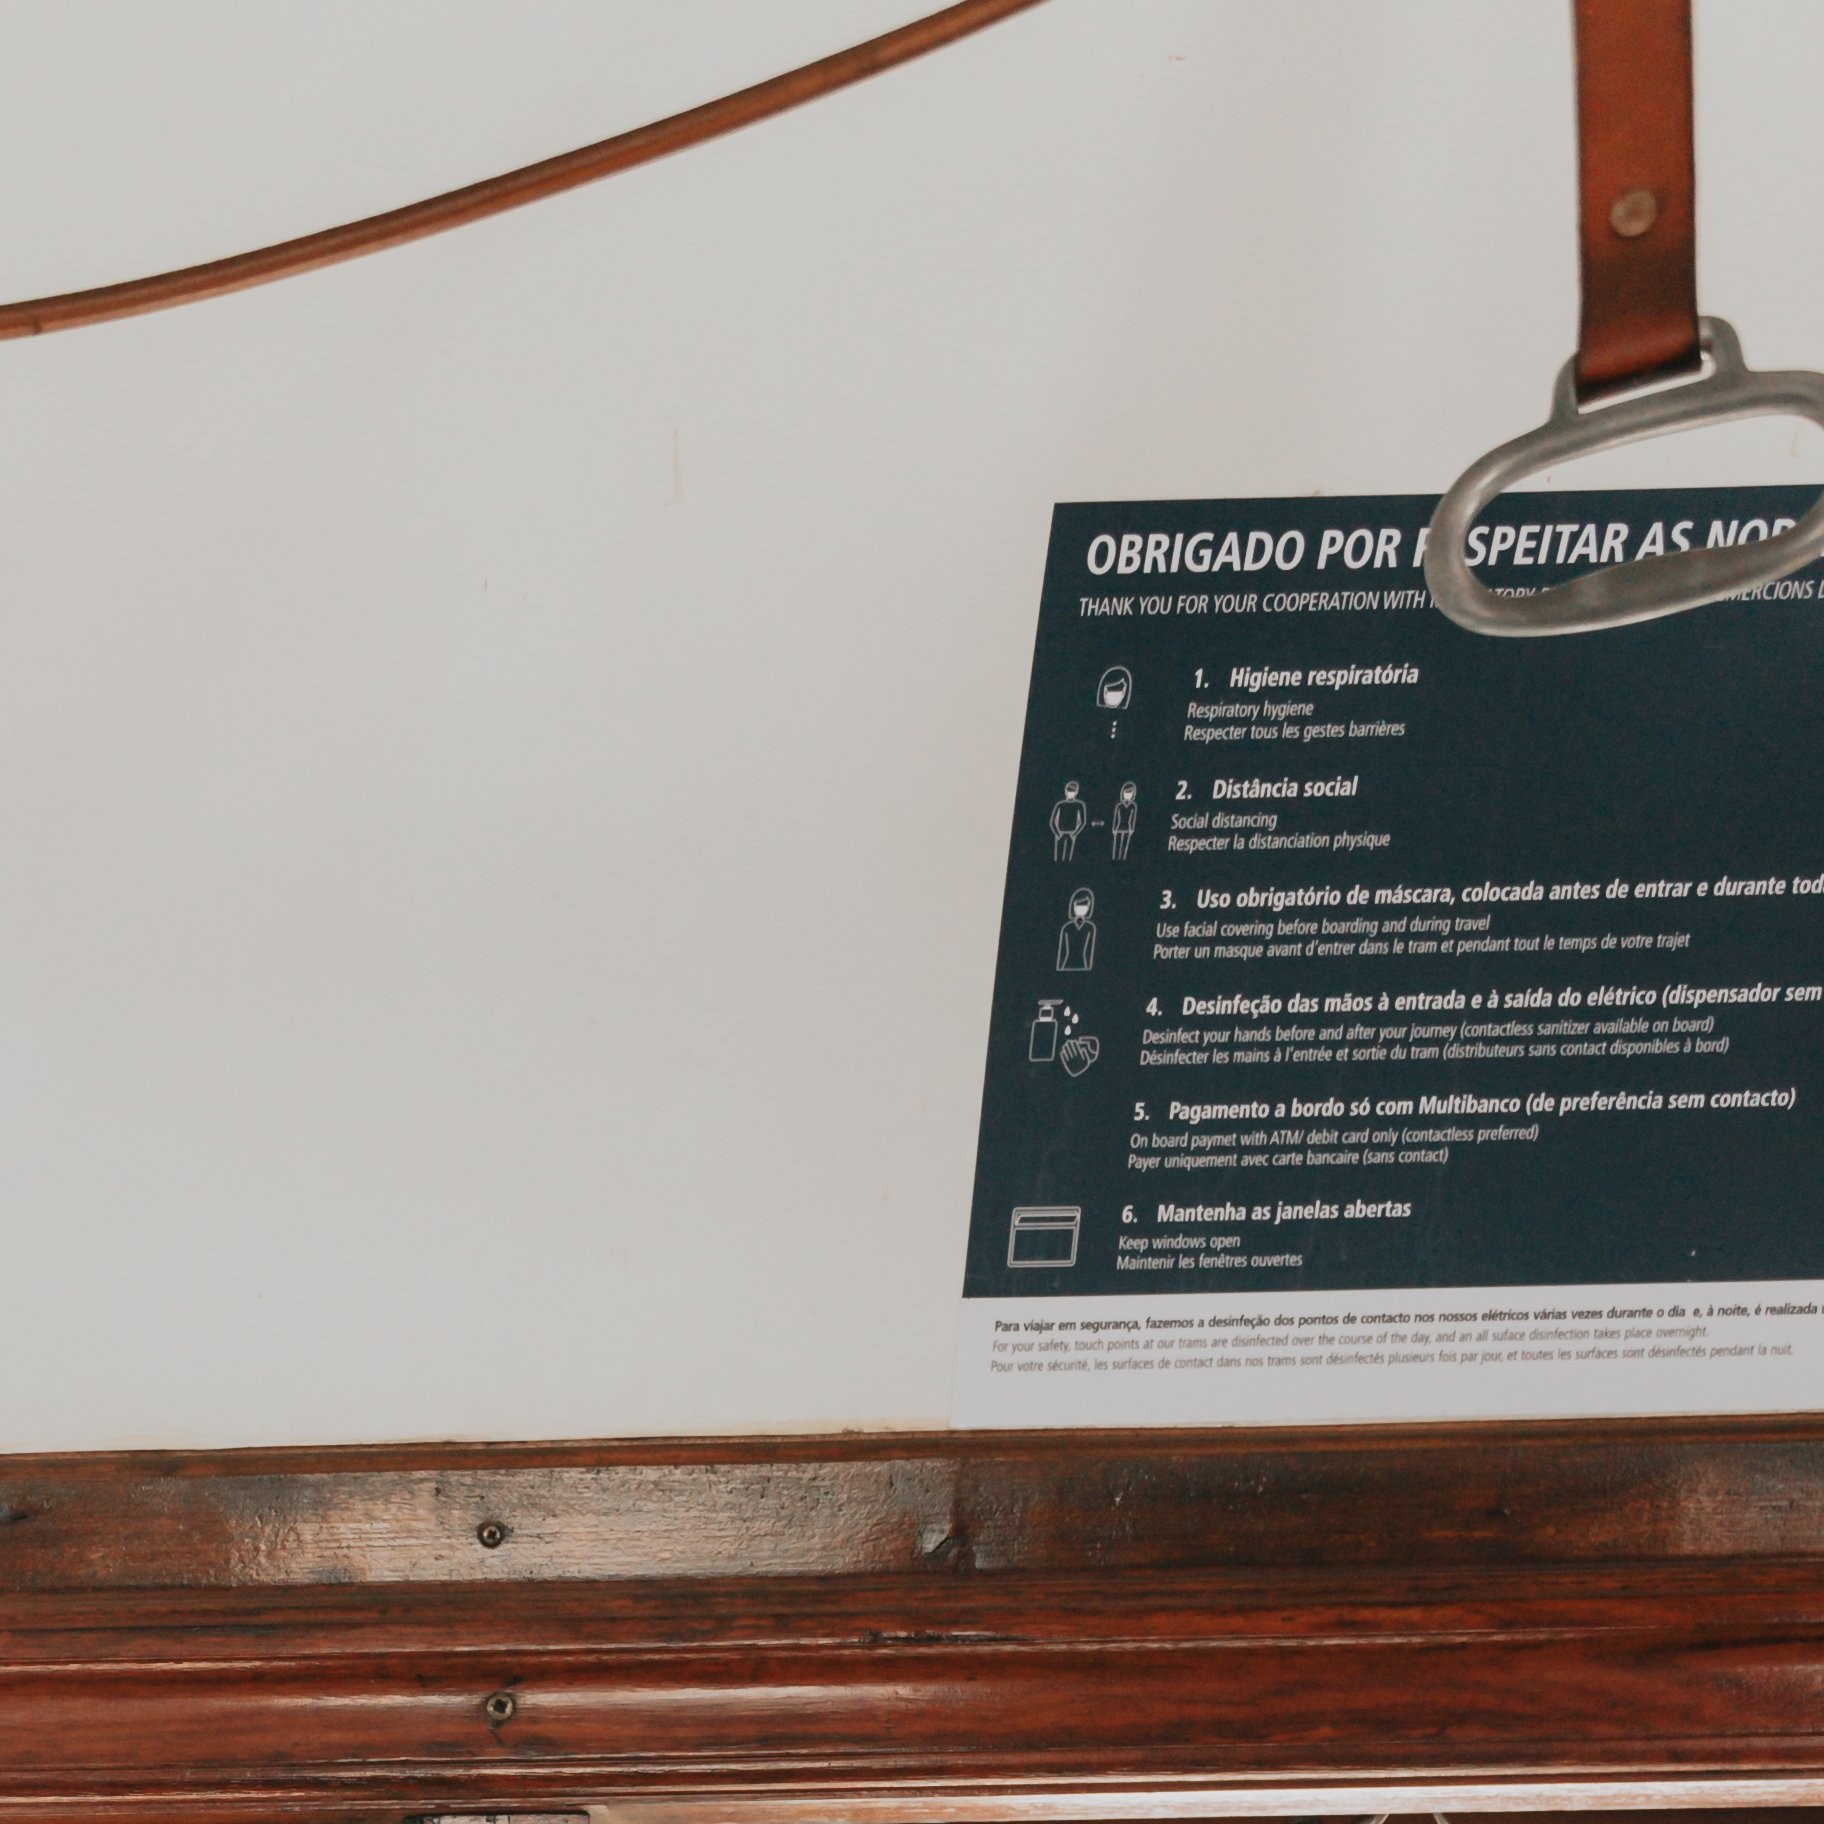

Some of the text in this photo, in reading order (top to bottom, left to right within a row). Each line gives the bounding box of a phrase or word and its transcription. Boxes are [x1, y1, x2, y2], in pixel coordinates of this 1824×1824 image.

[1086, 530, 1305, 576] OBRIGADO
[1316, 527, 1403, 570] POR
[1412, 522, 1629, 568] SPEITAR
[1635, 520, 1694, 562] AS
[1079, 596, 1135, 617] THANK
[1139, 595, 1173, 616] YOU
[1176, 594, 1209, 615] FOR
[1213, 593, 1258, 614] YOUR
[1262, 590, 1380, 613] COOPERATION
[1383, 589, 1426, 610] WITH
[1194, 662, 1419, 693] 1. Higiene respiratória
[1187, 699, 1315, 722] Respiratory hygiene
[1183, 719, 1406, 745] Respecter tous les gestes barrières
[1175, 775, 1359, 800] 2. Distância social
[1170, 811, 1278, 832] Social distancing
[1167, 830, 1391, 855] Respecter la distanciation physique
[1159, 872, 1824, 912] 3. Uso obrigatório de máscara, colocada antes de entrar e durante tod
[1156, 913, 1491, 940] Use facial covering before boarding and during travel
[1145, 982, 1823, 1019] 4. Desinfeção das mãos à entrada e à saída do elétrico (dispensador sem
[1133, 1087, 1796, 1125] 5. Pagamento a bordo só com Multibanco (de preferência sem contacto)
[1130, 1123, 1540, 1151] On board paymet with ATM/ debit card only (contactless preferred)
[1127, 1146, 1449, 1173] Payer uniquement avec carte bancaire (sans contact)
[1121, 1199, 1412, 1225] 6. Mantenha as janelas abertas
[1118, 1233, 1241, 1254] Keep windows open
[1116, 1252, 1303, 1271] Maintenir les fenêtres ouvertes
[994, 1320, 1020, 1332] Para
[1023, 1318, 1056, 1336] viajar
[1057, 1321, 1078, 1333] em
[1079, 1320, 1142, 1334] segurança,
[1145, 1316, 1195, 1329] fazemos
[1207, 1313, 1271, 1330] desinfeção
[1273, 1313, 1295, 1327] dos
[1297, 1314, 1339, 1329] pontos
[1342, 1311, 1358, 1325] de
[1360, 1312, 1411, 1325] contacto
[1413, 1313, 1435, 1323] nos
[1438, 1312, 1478, 1323] nossos
[1481, 1308, 1530, 1322] elétricos
[1533, 1308, 1568, 1321] várias
[1570, 1309, 1604, 1320] vezes
[1606, 1306, 1654, 1319] durante
[1667, 1305, 1686, 1318] dia
[1692, 1307, 1703, 1319] e,
[1717, 1303, 1751, 1317] noite,
[1764, 1301, 1818, 1316] realizada
